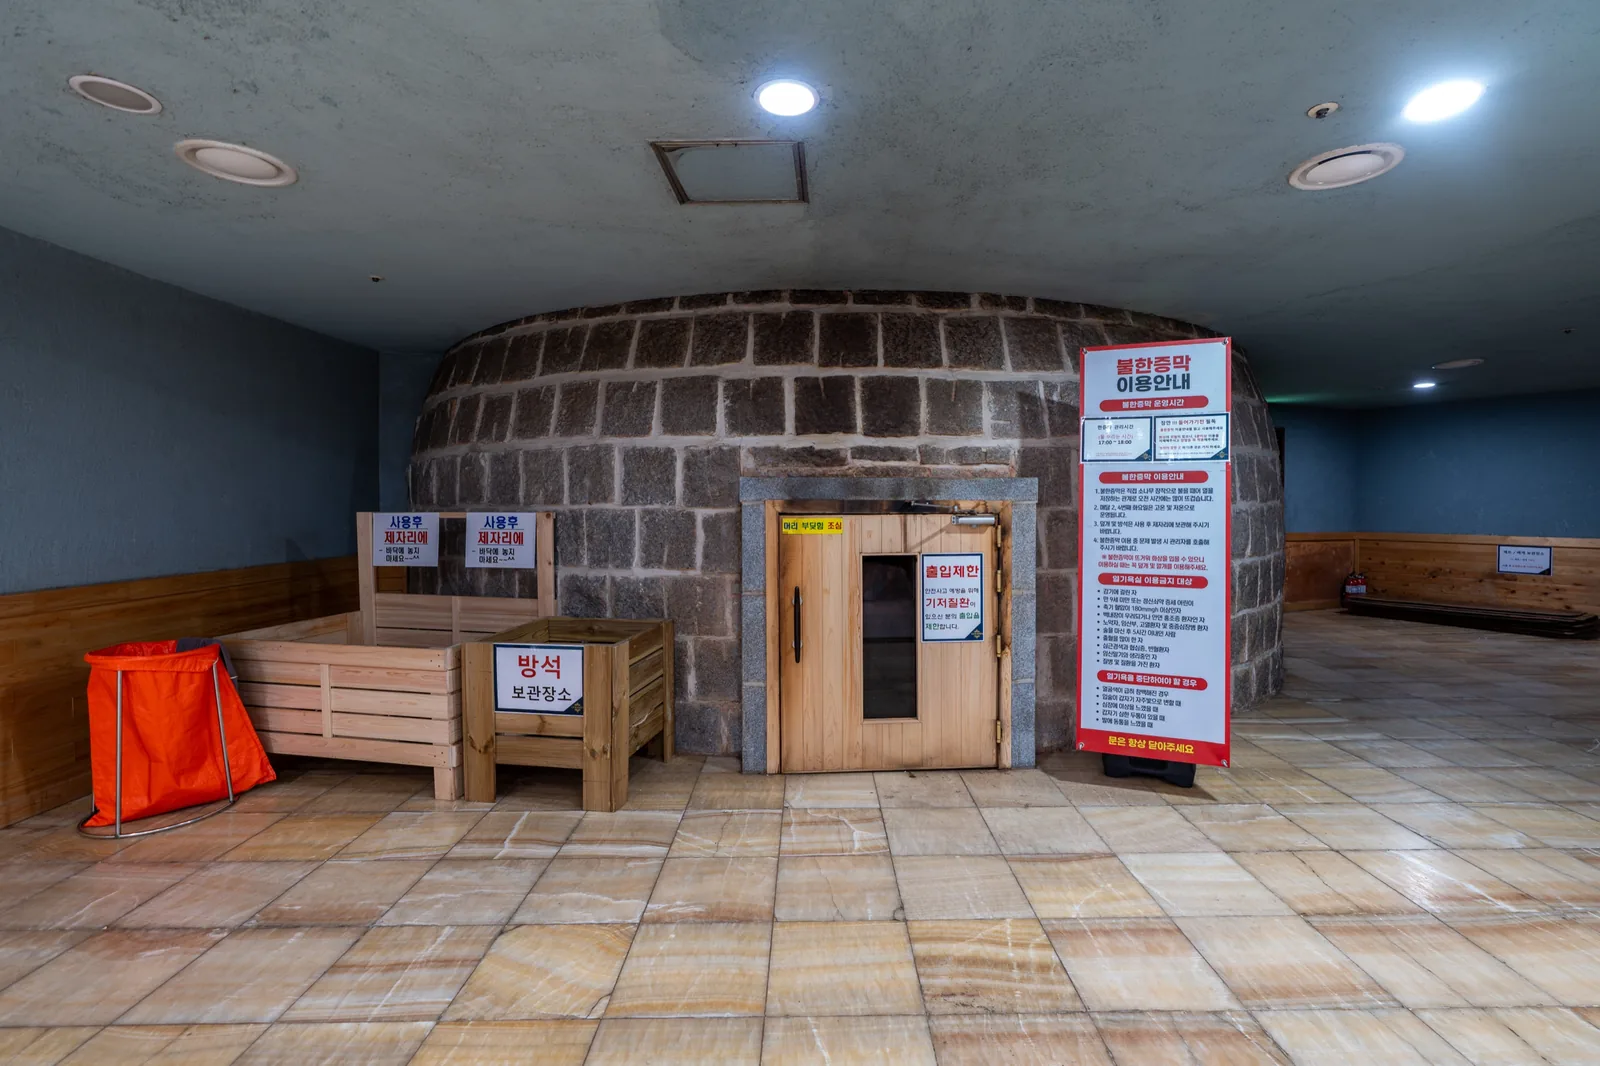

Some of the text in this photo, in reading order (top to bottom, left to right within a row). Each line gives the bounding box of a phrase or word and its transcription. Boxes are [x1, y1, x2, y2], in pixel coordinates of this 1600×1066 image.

[1117, 355, 1191, 375] 불한증막
[1117, 373, 1190, 392] 이용안내
[1122, 399, 1184, 408] 불한증막 운영시간
[390, 516, 422, 529] 사용후
[484, 516, 518, 529] 사용후
[784, 522, 798, 530] 머리
[828, 522, 842, 530] 조심
[384, 531, 428, 544] 제자리에
[478, 531, 524, 545] 제자리에
[386, 547, 404, 555] 바닥에
[926, 565, 979, 578] 출입제한
[1113, 576, 1142, 584] 열기욕실
[1144, 577, 1174, 585] 이용금지
[925, 598, 976, 608] 기저질환이
[518, 655, 561, 679] 방석
[1107, 673, 1197, 687] 열기욕을 할 경우
[512, 686, 572, 702] 보관장소
[1108, 736, 1194, 754] 문은 항상 닫아주세요
